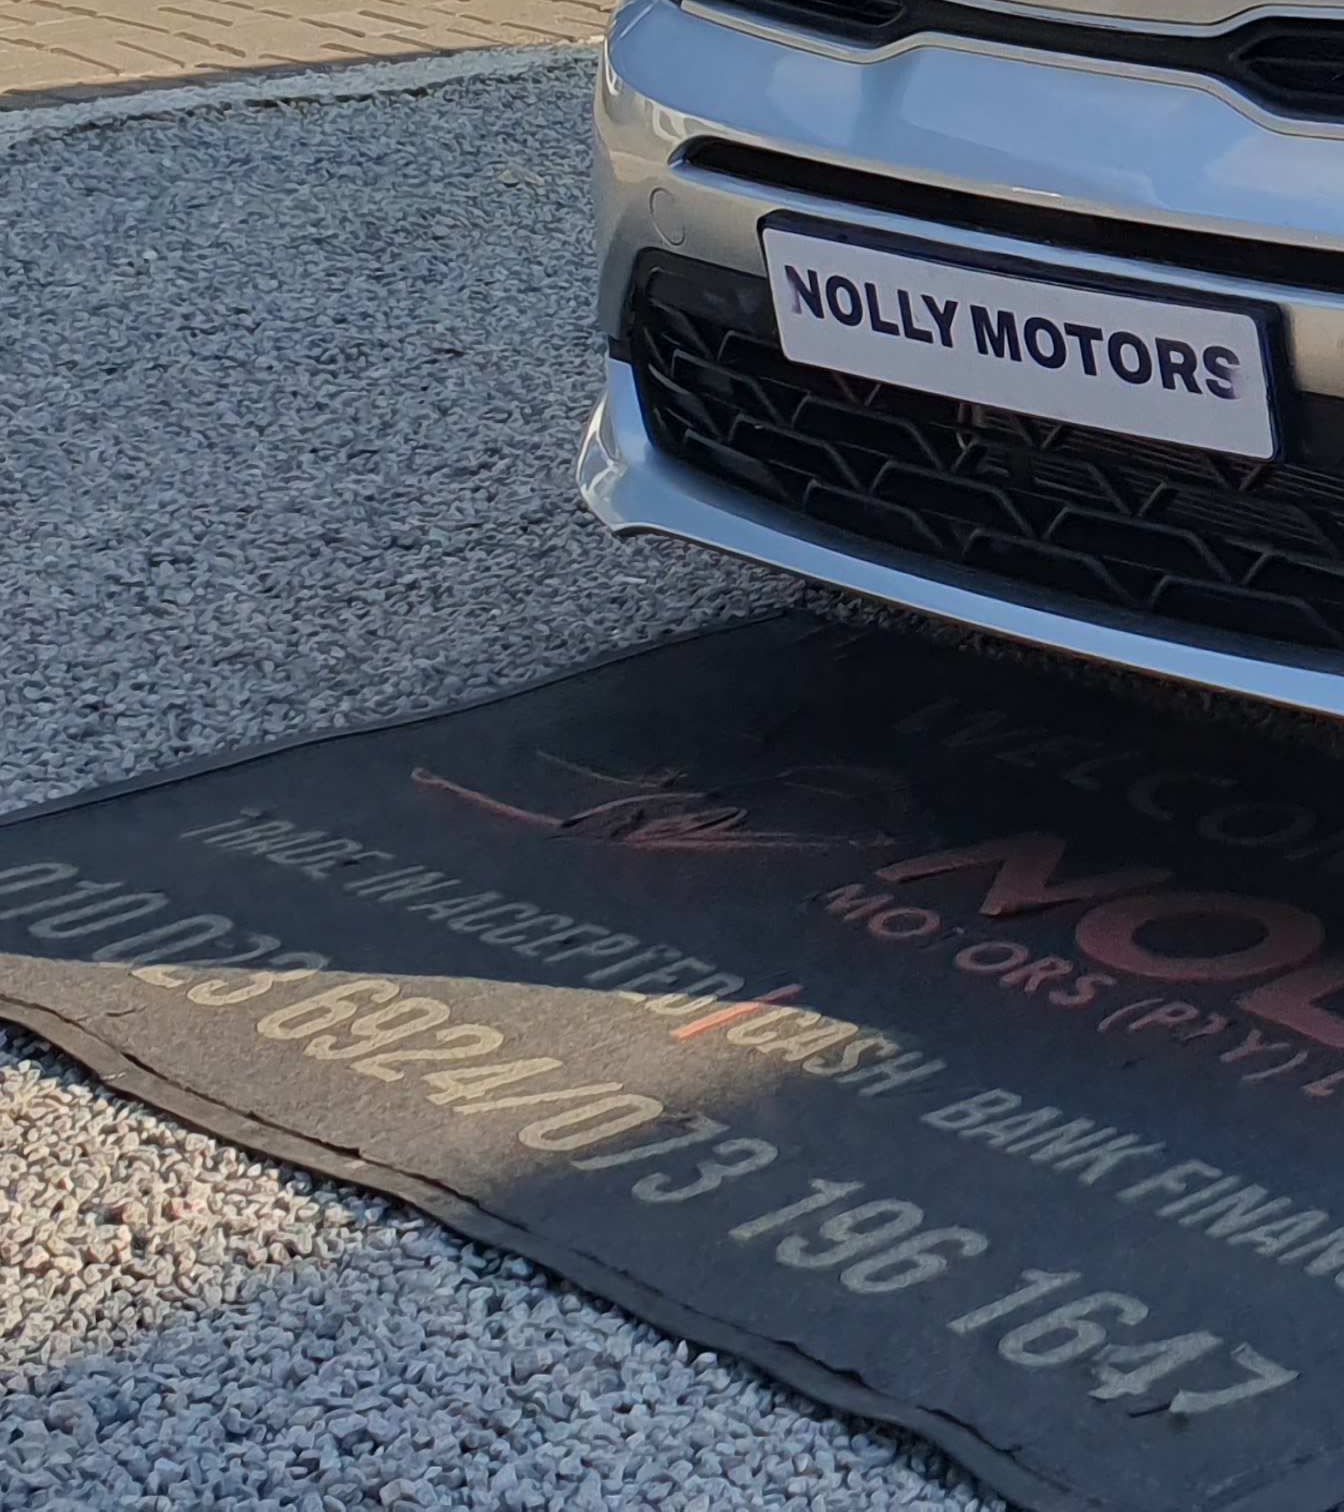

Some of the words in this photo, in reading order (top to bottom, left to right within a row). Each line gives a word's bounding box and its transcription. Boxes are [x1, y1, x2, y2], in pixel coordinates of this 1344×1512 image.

[785, 264, 958, 348] NOLLY
[969, 304, 1240, 400] MOTORS
[179, 808, 396, 880] TRADE
[920, 1088, 1167, 1186] BANK
[728, 1178, 990, 1294] 196
[947, 1268, 1300, 1414] 1647
